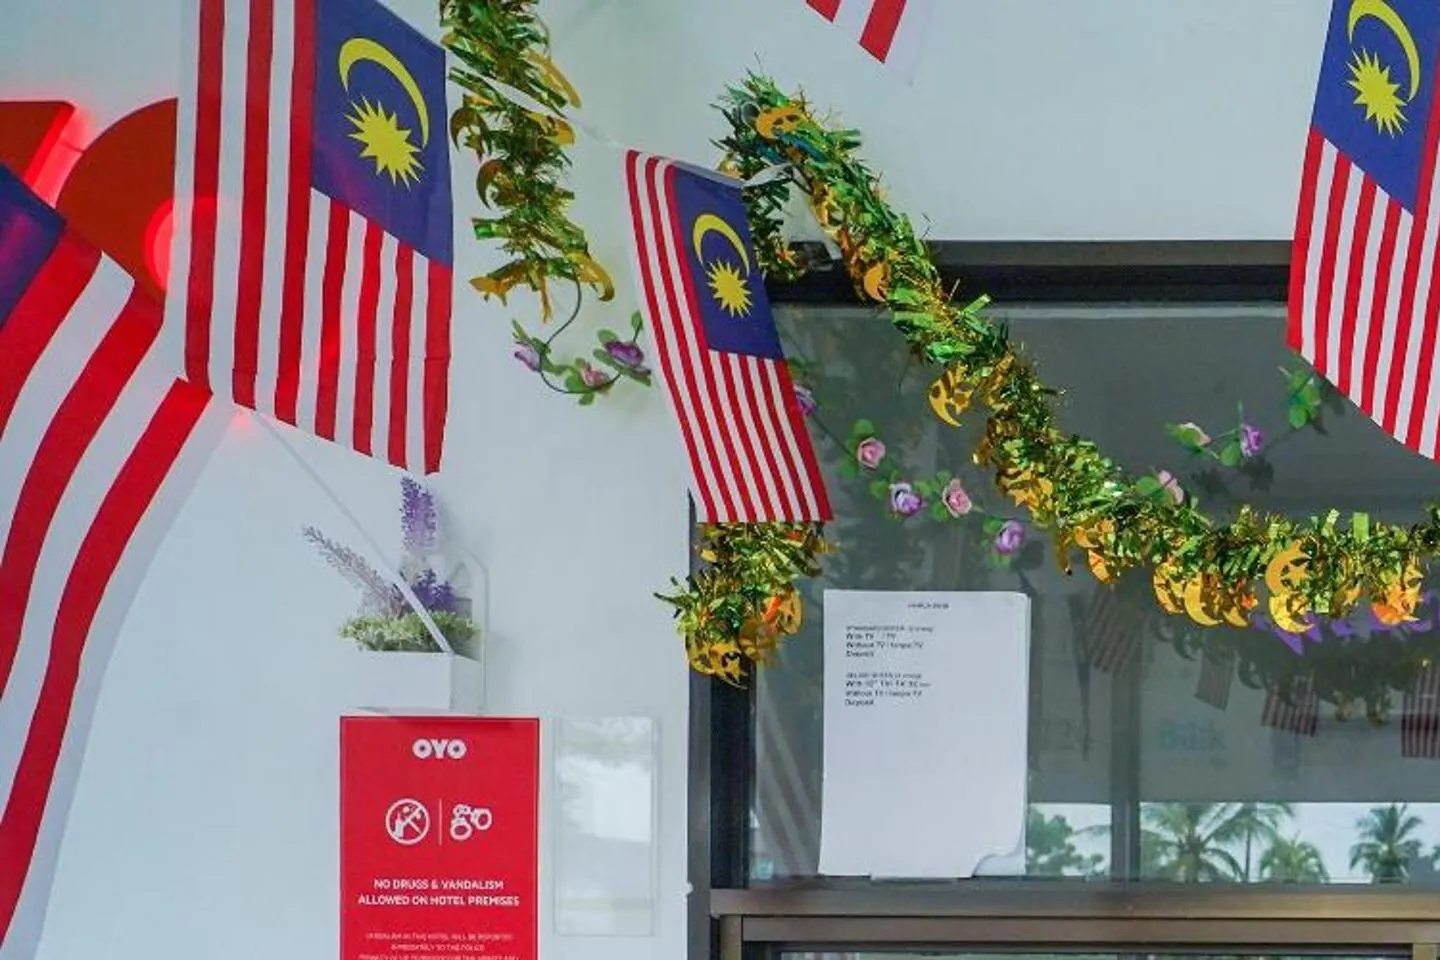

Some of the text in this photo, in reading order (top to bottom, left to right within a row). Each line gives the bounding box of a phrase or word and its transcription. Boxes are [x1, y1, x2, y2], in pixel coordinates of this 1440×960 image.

[412, 738, 467, 759] OYO
[373, 879, 504, 890] NO DRUGS & VANDALISM
[358, 895, 520, 907] ALLOWED ON HOTEL PREMISES
